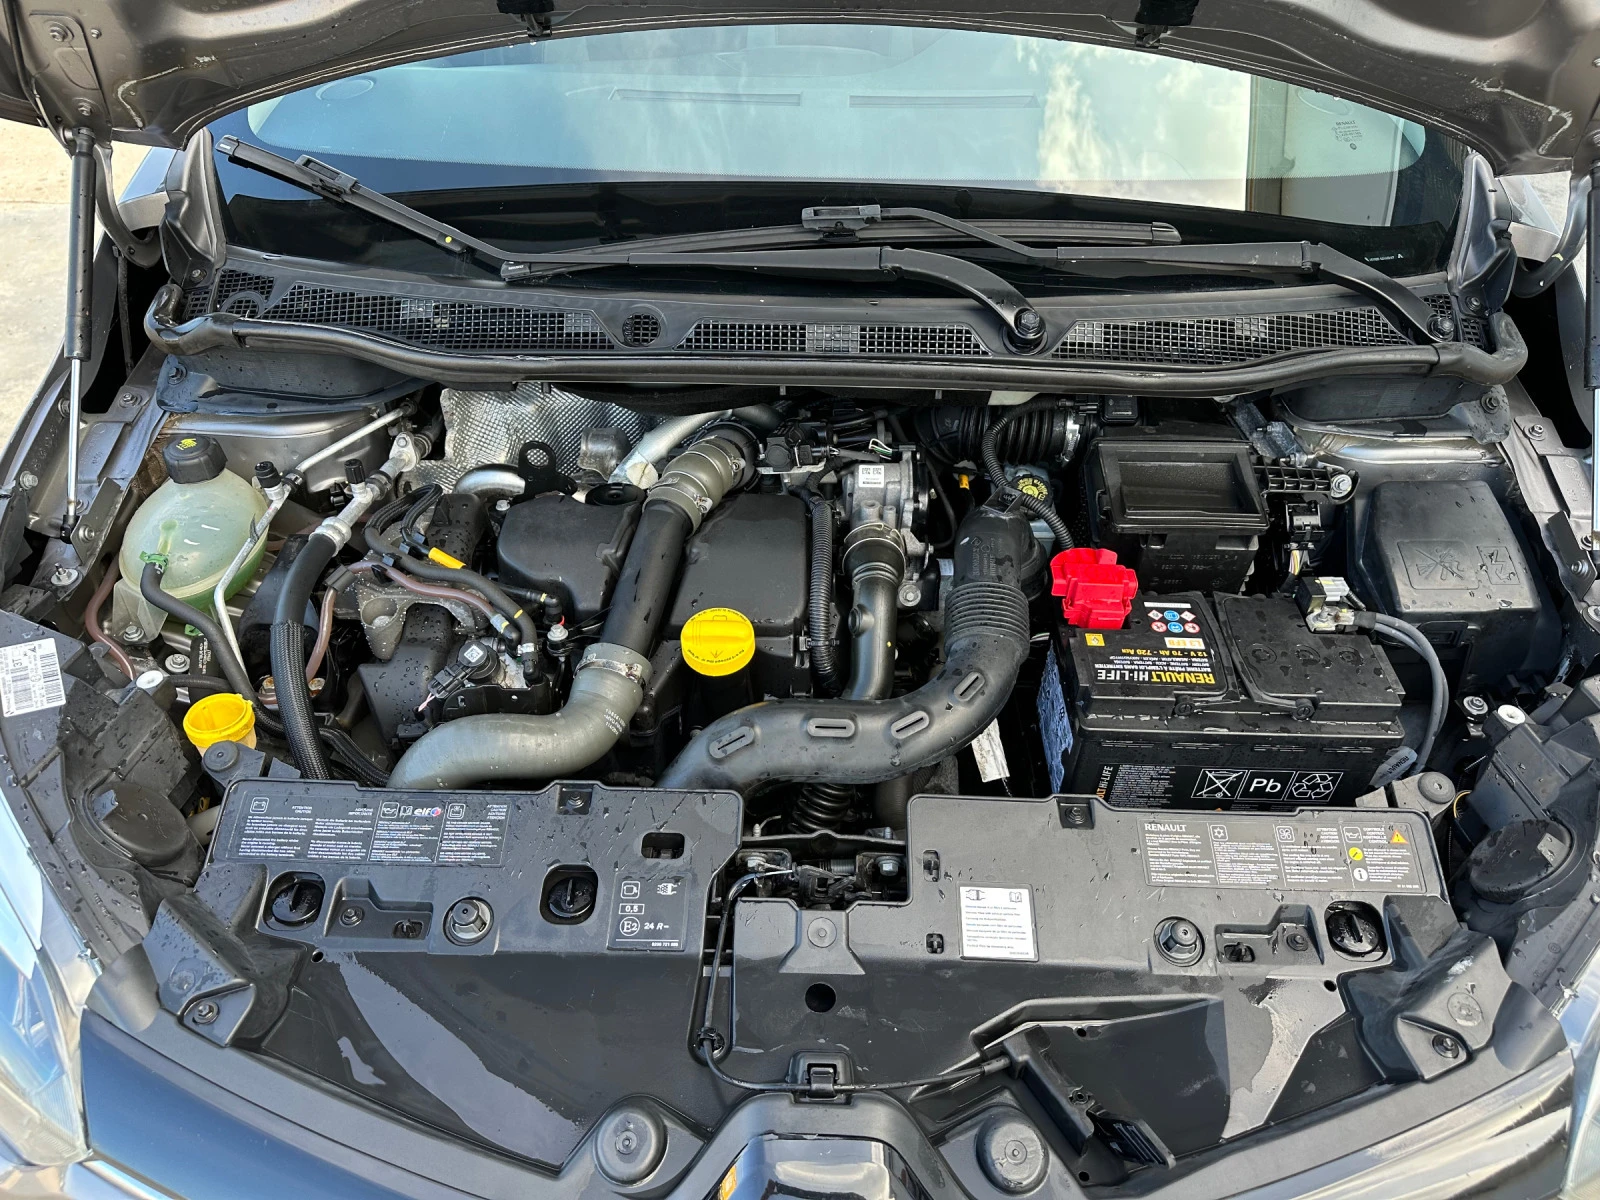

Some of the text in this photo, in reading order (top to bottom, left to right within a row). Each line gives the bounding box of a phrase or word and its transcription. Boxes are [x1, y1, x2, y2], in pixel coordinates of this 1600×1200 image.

[1151, 671, 1215, 684] RENAULT
[1249, 778, 1282, 793] Pb
[413, 807, 431, 816] elf
[1144, 822, 1187, 832] RENAULT
[625, 905, 639, 913] 0,5
[623, 921, 638, 932] E2
